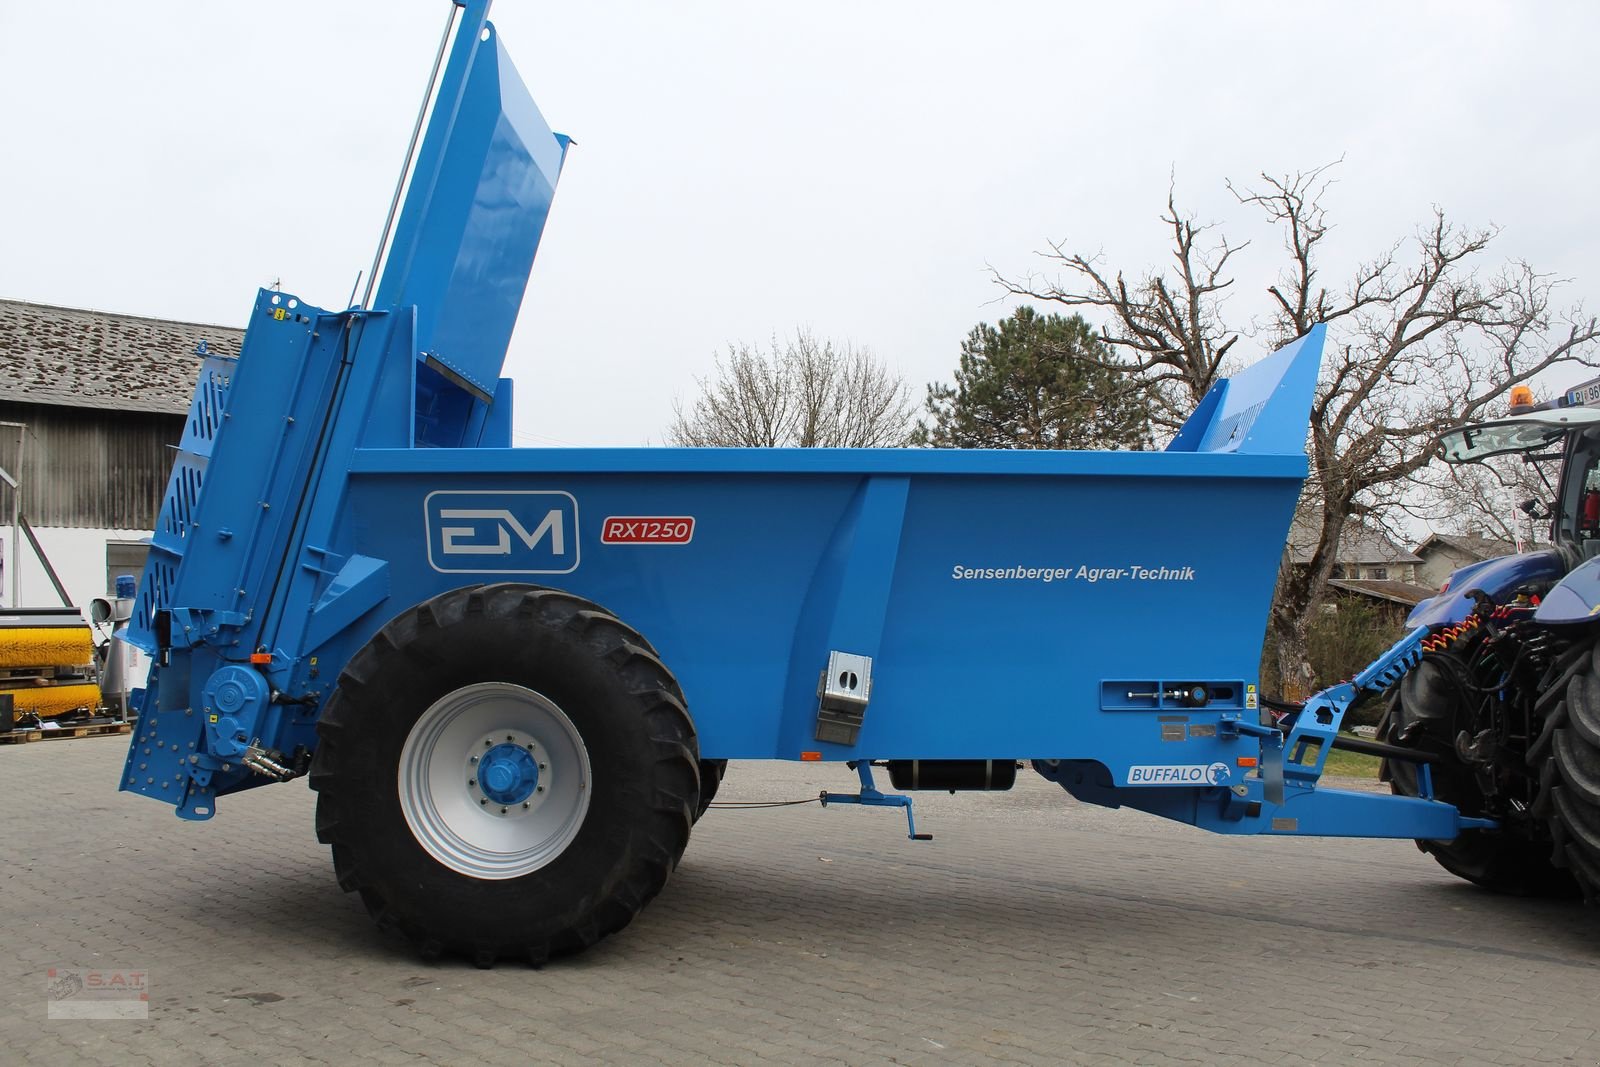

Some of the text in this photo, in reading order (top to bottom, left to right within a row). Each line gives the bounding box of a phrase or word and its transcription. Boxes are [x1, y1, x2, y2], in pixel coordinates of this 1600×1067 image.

[1589, 384, 1600, 400] 96
[440, 509, 565, 555] EM
[608, 522, 688, 538] RX1250
[951, 565, 1196, 583] Sensenberger Agrar-Technik
[1132, 768, 1202, 781] BUFFALO
